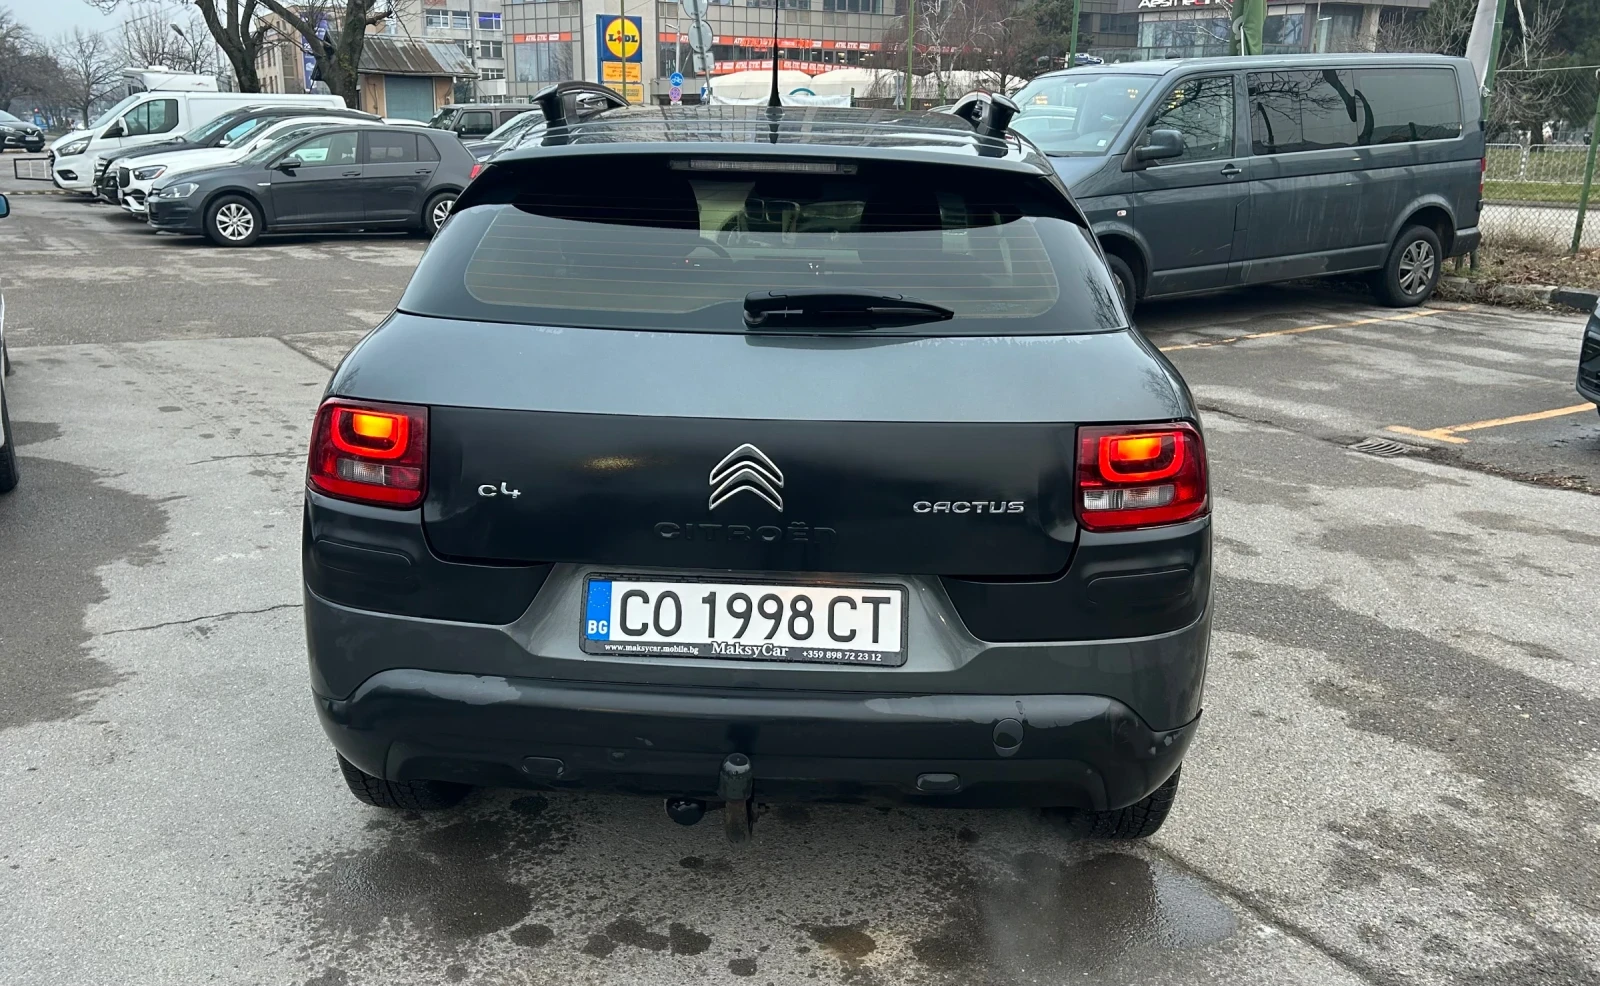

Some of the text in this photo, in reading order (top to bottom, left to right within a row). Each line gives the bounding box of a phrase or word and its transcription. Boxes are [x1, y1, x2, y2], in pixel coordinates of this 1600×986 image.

[913, 501, 1024, 513] CACTUS
[654, 521, 837, 543] CITROËN
[620, 589, 891, 643] CO 1998 CT
[587, 620, 608, 634] BG
[604, 643, 699, 654] www.maksycar.mobile.bg
[711, 641, 789, 657] MaksyCar
[826, 651, 842, 659] 898
[844, 652, 855, 660] 72
[871, 653, 881, 661] 12
